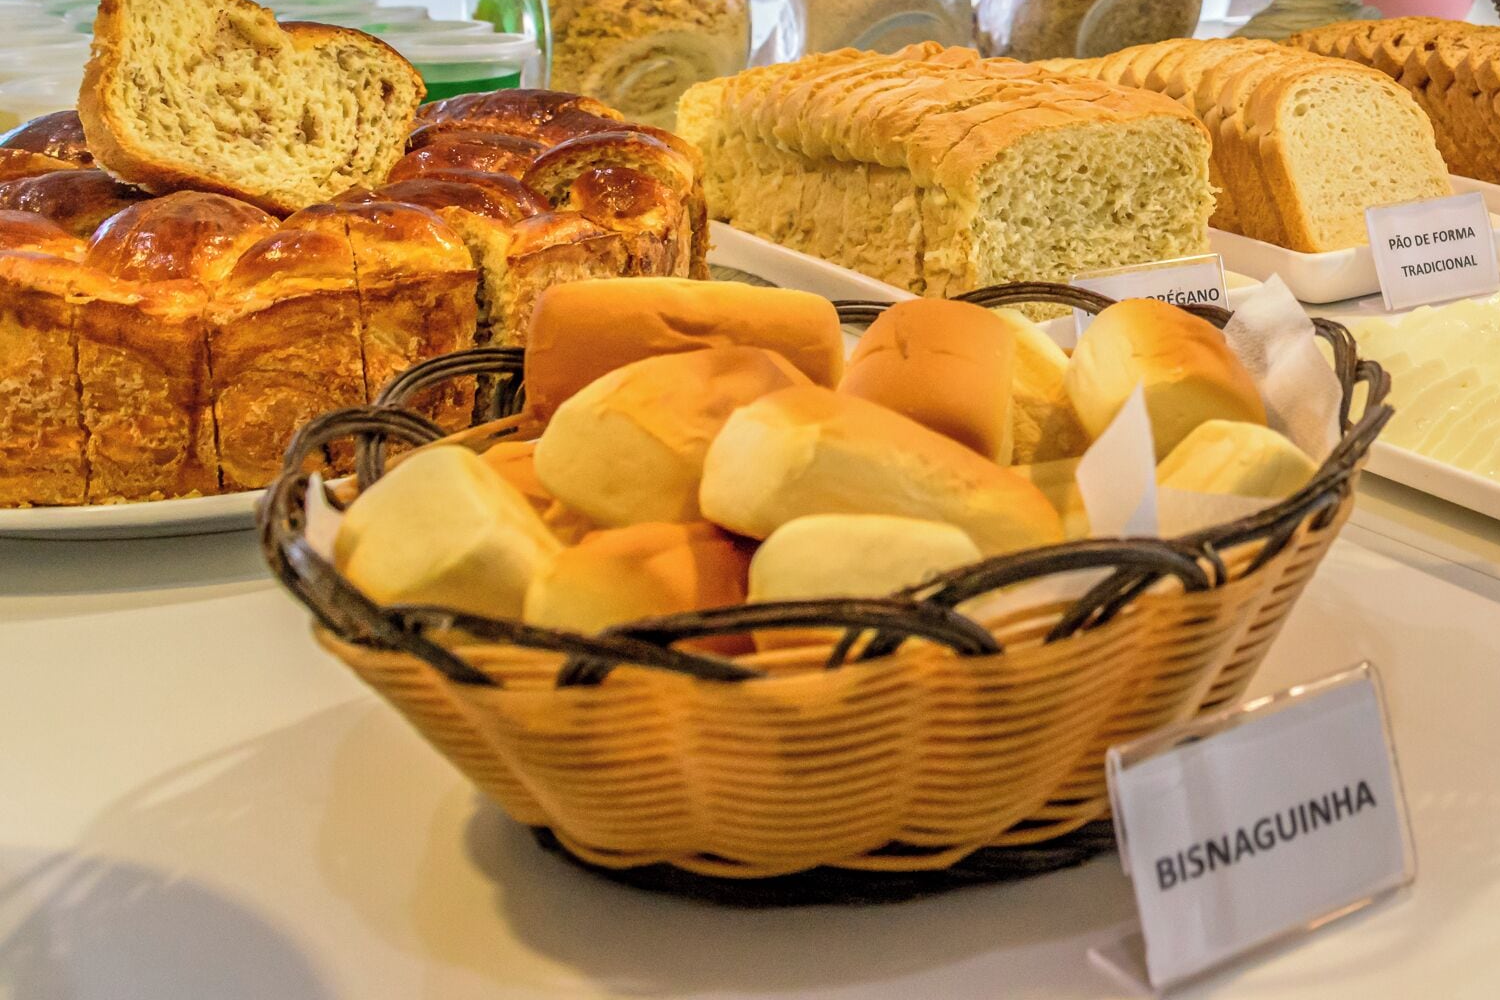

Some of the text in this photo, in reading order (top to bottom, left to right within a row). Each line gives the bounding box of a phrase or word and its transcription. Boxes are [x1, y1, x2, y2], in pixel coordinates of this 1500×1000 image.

[1388, 226, 1476, 250] PÃO DE FORMA
[1401, 255, 1478, 278] TRADICIONAL
[1155, 780, 1377, 893] BISNAGUINHA
